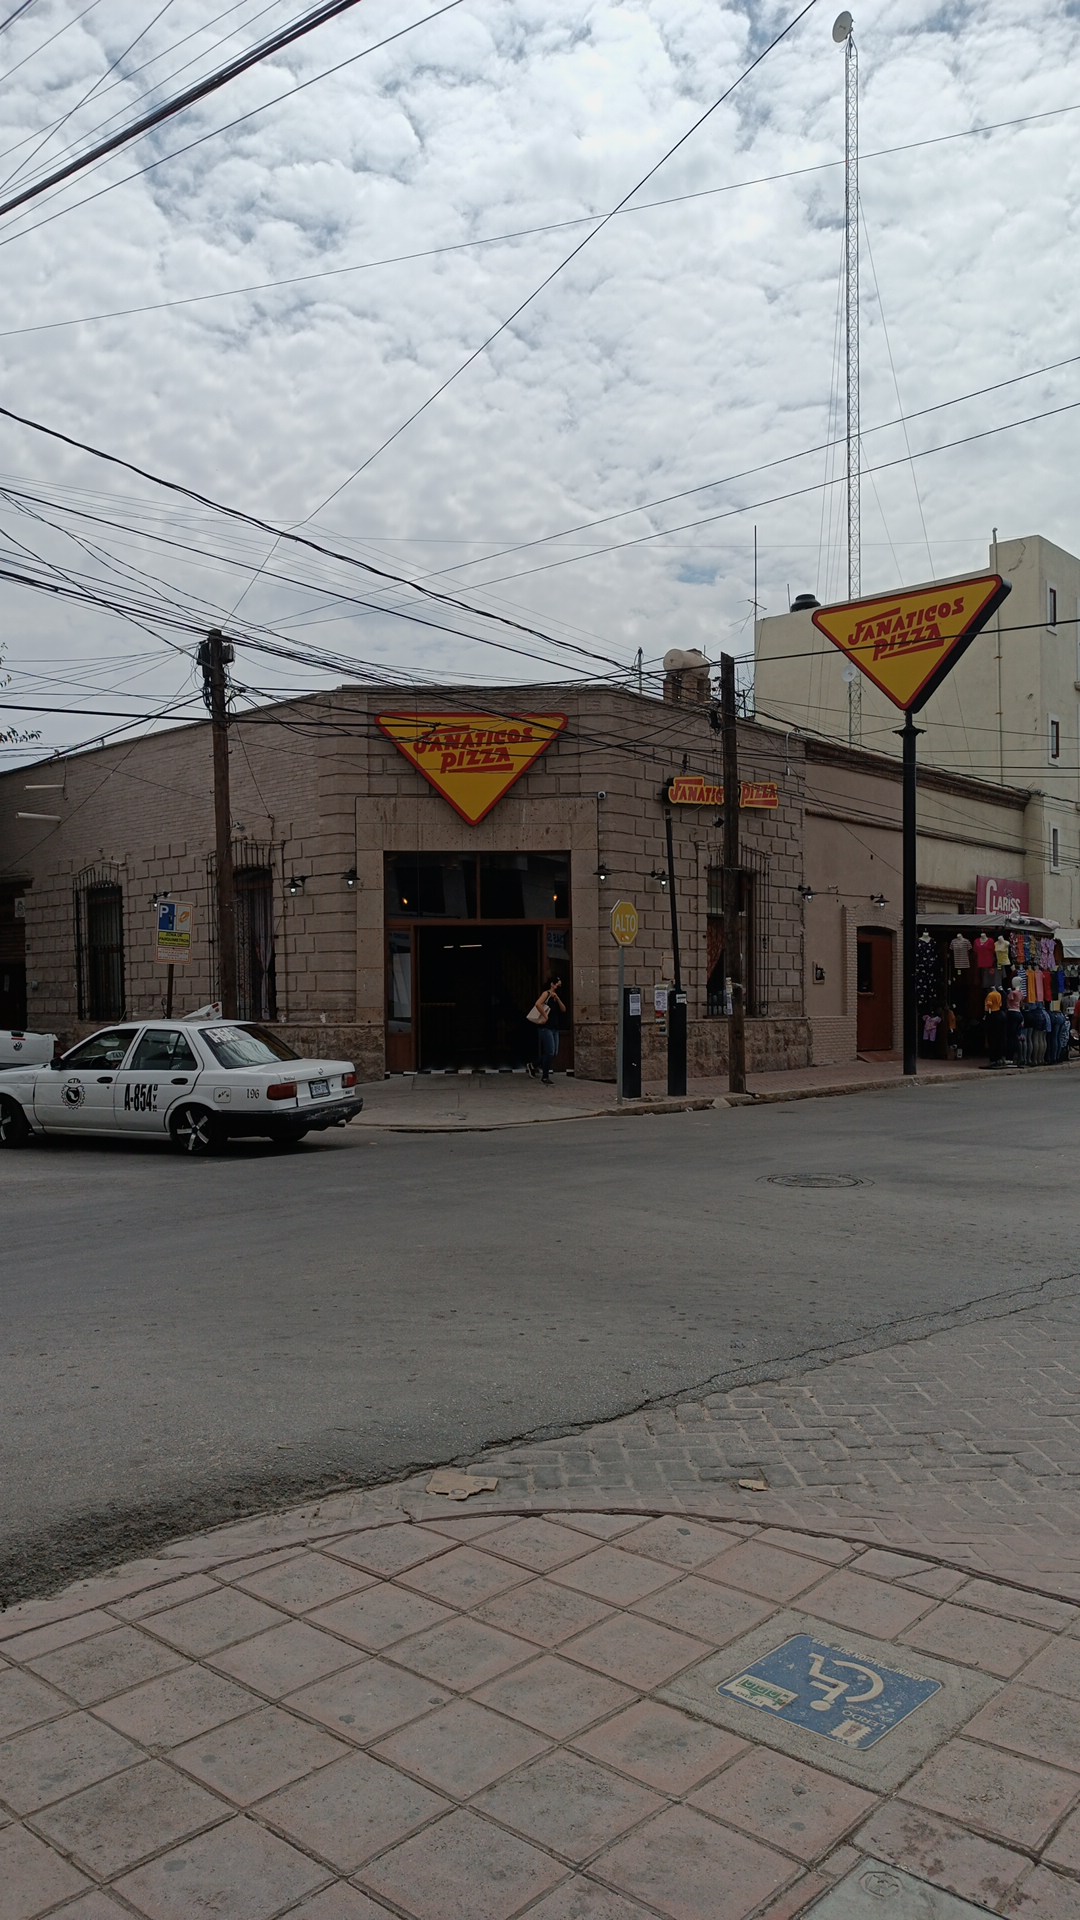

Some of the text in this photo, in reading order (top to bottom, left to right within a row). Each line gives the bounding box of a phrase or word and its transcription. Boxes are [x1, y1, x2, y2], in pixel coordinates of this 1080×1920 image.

[848, 597, 964, 645] FANATICOS
[873, 623, 944, 662] PIZZA
[413, 725, 533, 754] FANATICOS
[440, 747, 514, 773] PIZZA
[669, 778, 778, 806] FANATIC PIZZA
[160, 905, 170, 918] P
[615, 914, 636, 932] ALTO
[125, 1084, 152, 1111] A-854
[246, 1088, 260, 1099] 196
[842, 1709, 887, 1730] LERDO
